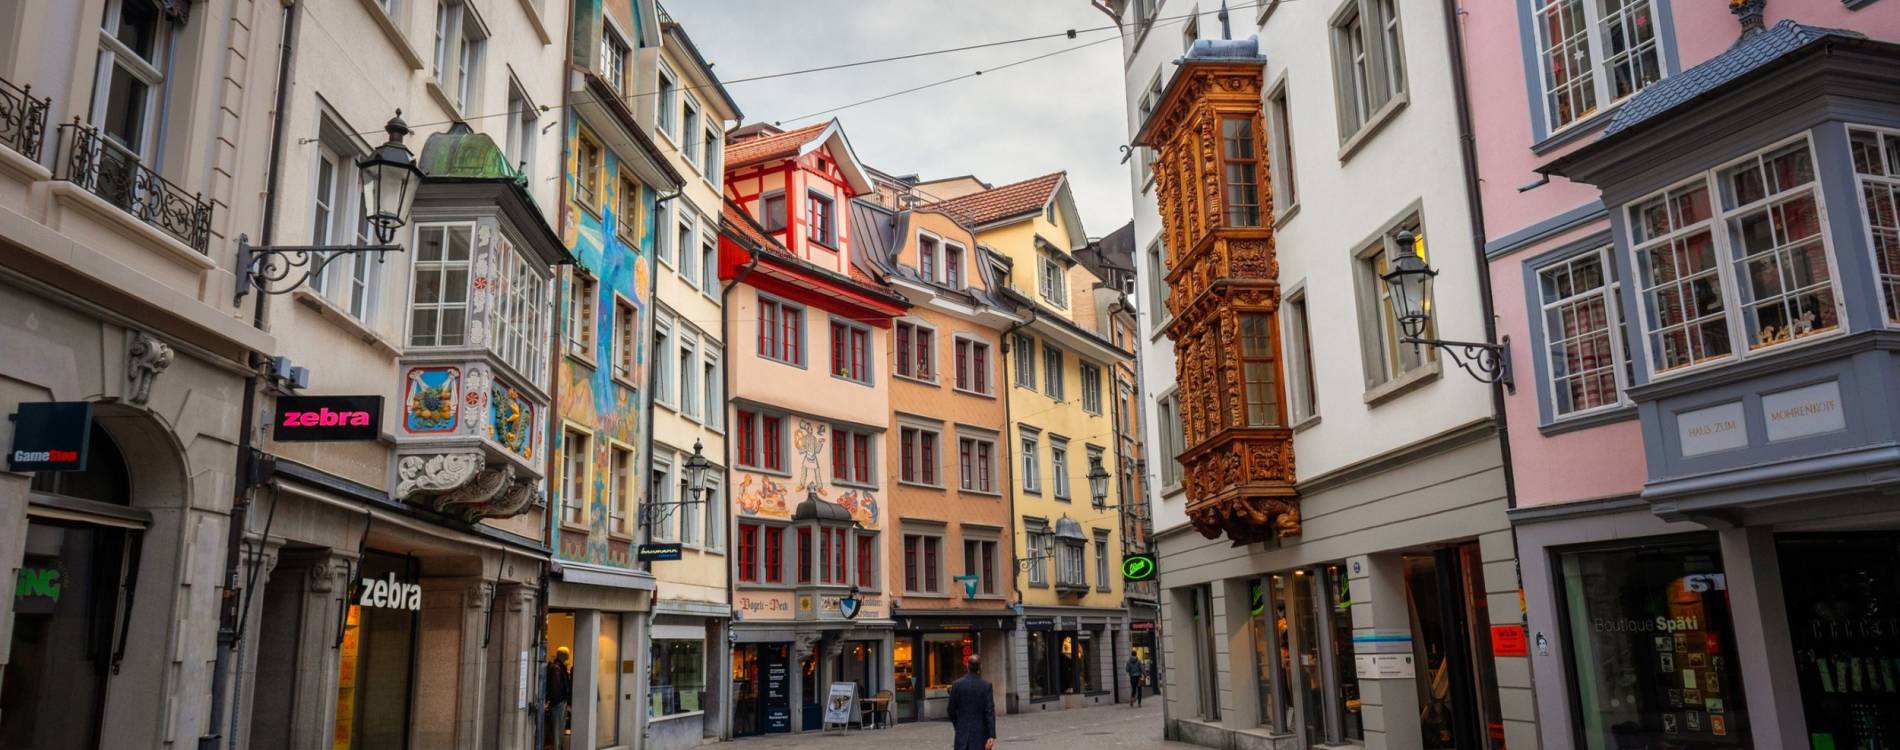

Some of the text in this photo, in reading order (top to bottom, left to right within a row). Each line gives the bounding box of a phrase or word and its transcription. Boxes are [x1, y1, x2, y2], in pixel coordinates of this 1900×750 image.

[283, 407, 370, 426] zebra
[1688, 420, 1736, 438] HAUS ZUM
[15, 449, 78, 463] GameStop
[360, 572, 422, 611] zebra
[1656, 615, 1699, 633] Späti
